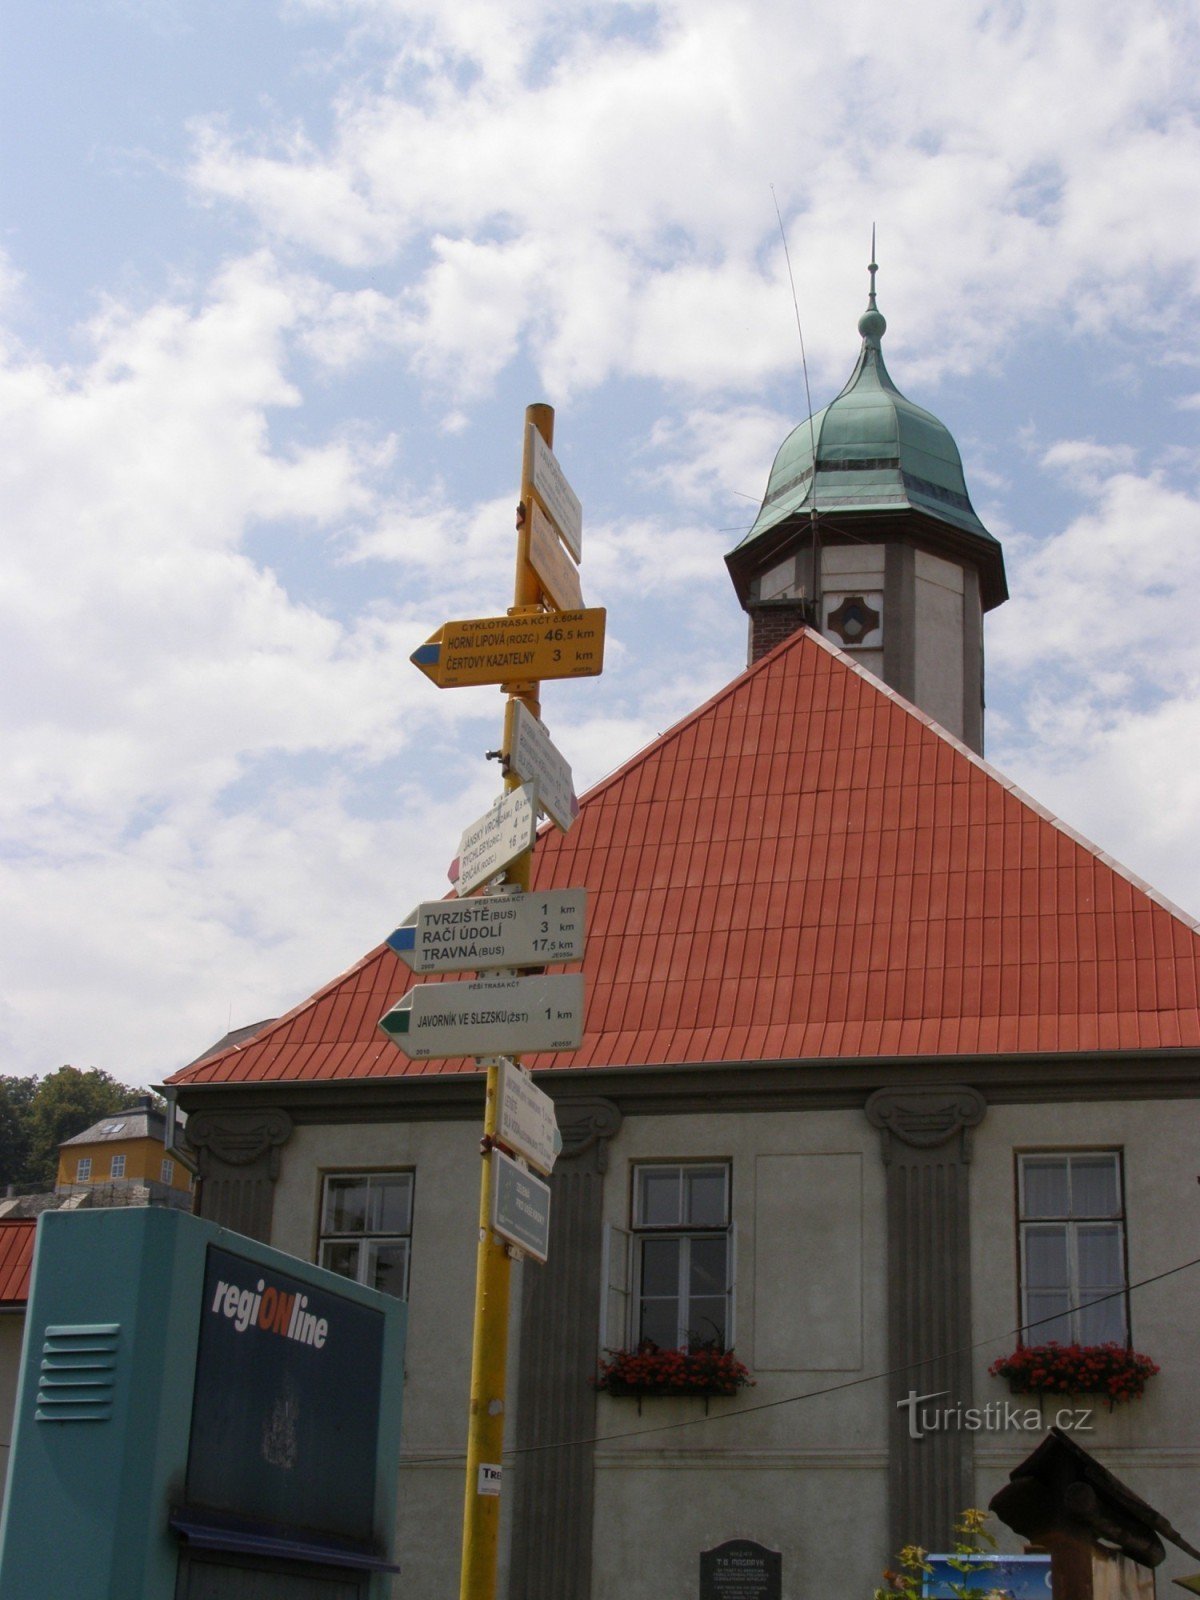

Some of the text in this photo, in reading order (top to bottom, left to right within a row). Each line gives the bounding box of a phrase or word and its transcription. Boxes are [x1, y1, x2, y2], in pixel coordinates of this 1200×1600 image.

[462, 619, 528, 632] CYKLOTRASA
[531, 615, 550, 625] KČT
[447, 634, 474, 650] HORNÍ
[475, 631, 505, 648] LIPOVÁ
[577, 629, 595, 639] km
[446, 651, 535, 671] ČERTOVY KAZATELNY
[552, 650, 593, 662] 3 km
[541, 904, 576, 916] 1 km
[422, 922, 502, 943] RAČÍ ÚDOLÍ
[540, 921, 575, 933] 3 km
[532, 939, 574, 952] 17,5 km
[484, 982, 505, 990] TRASA
[506, 981, 520, 989] KČT
[544, 1007, 573, 1020] 1 km
[417, 1012, 456, 1029] JAVORNÍK
[458, 1012, 469, 1026] VE
[211, 1279, 329, 1349] regiONline
